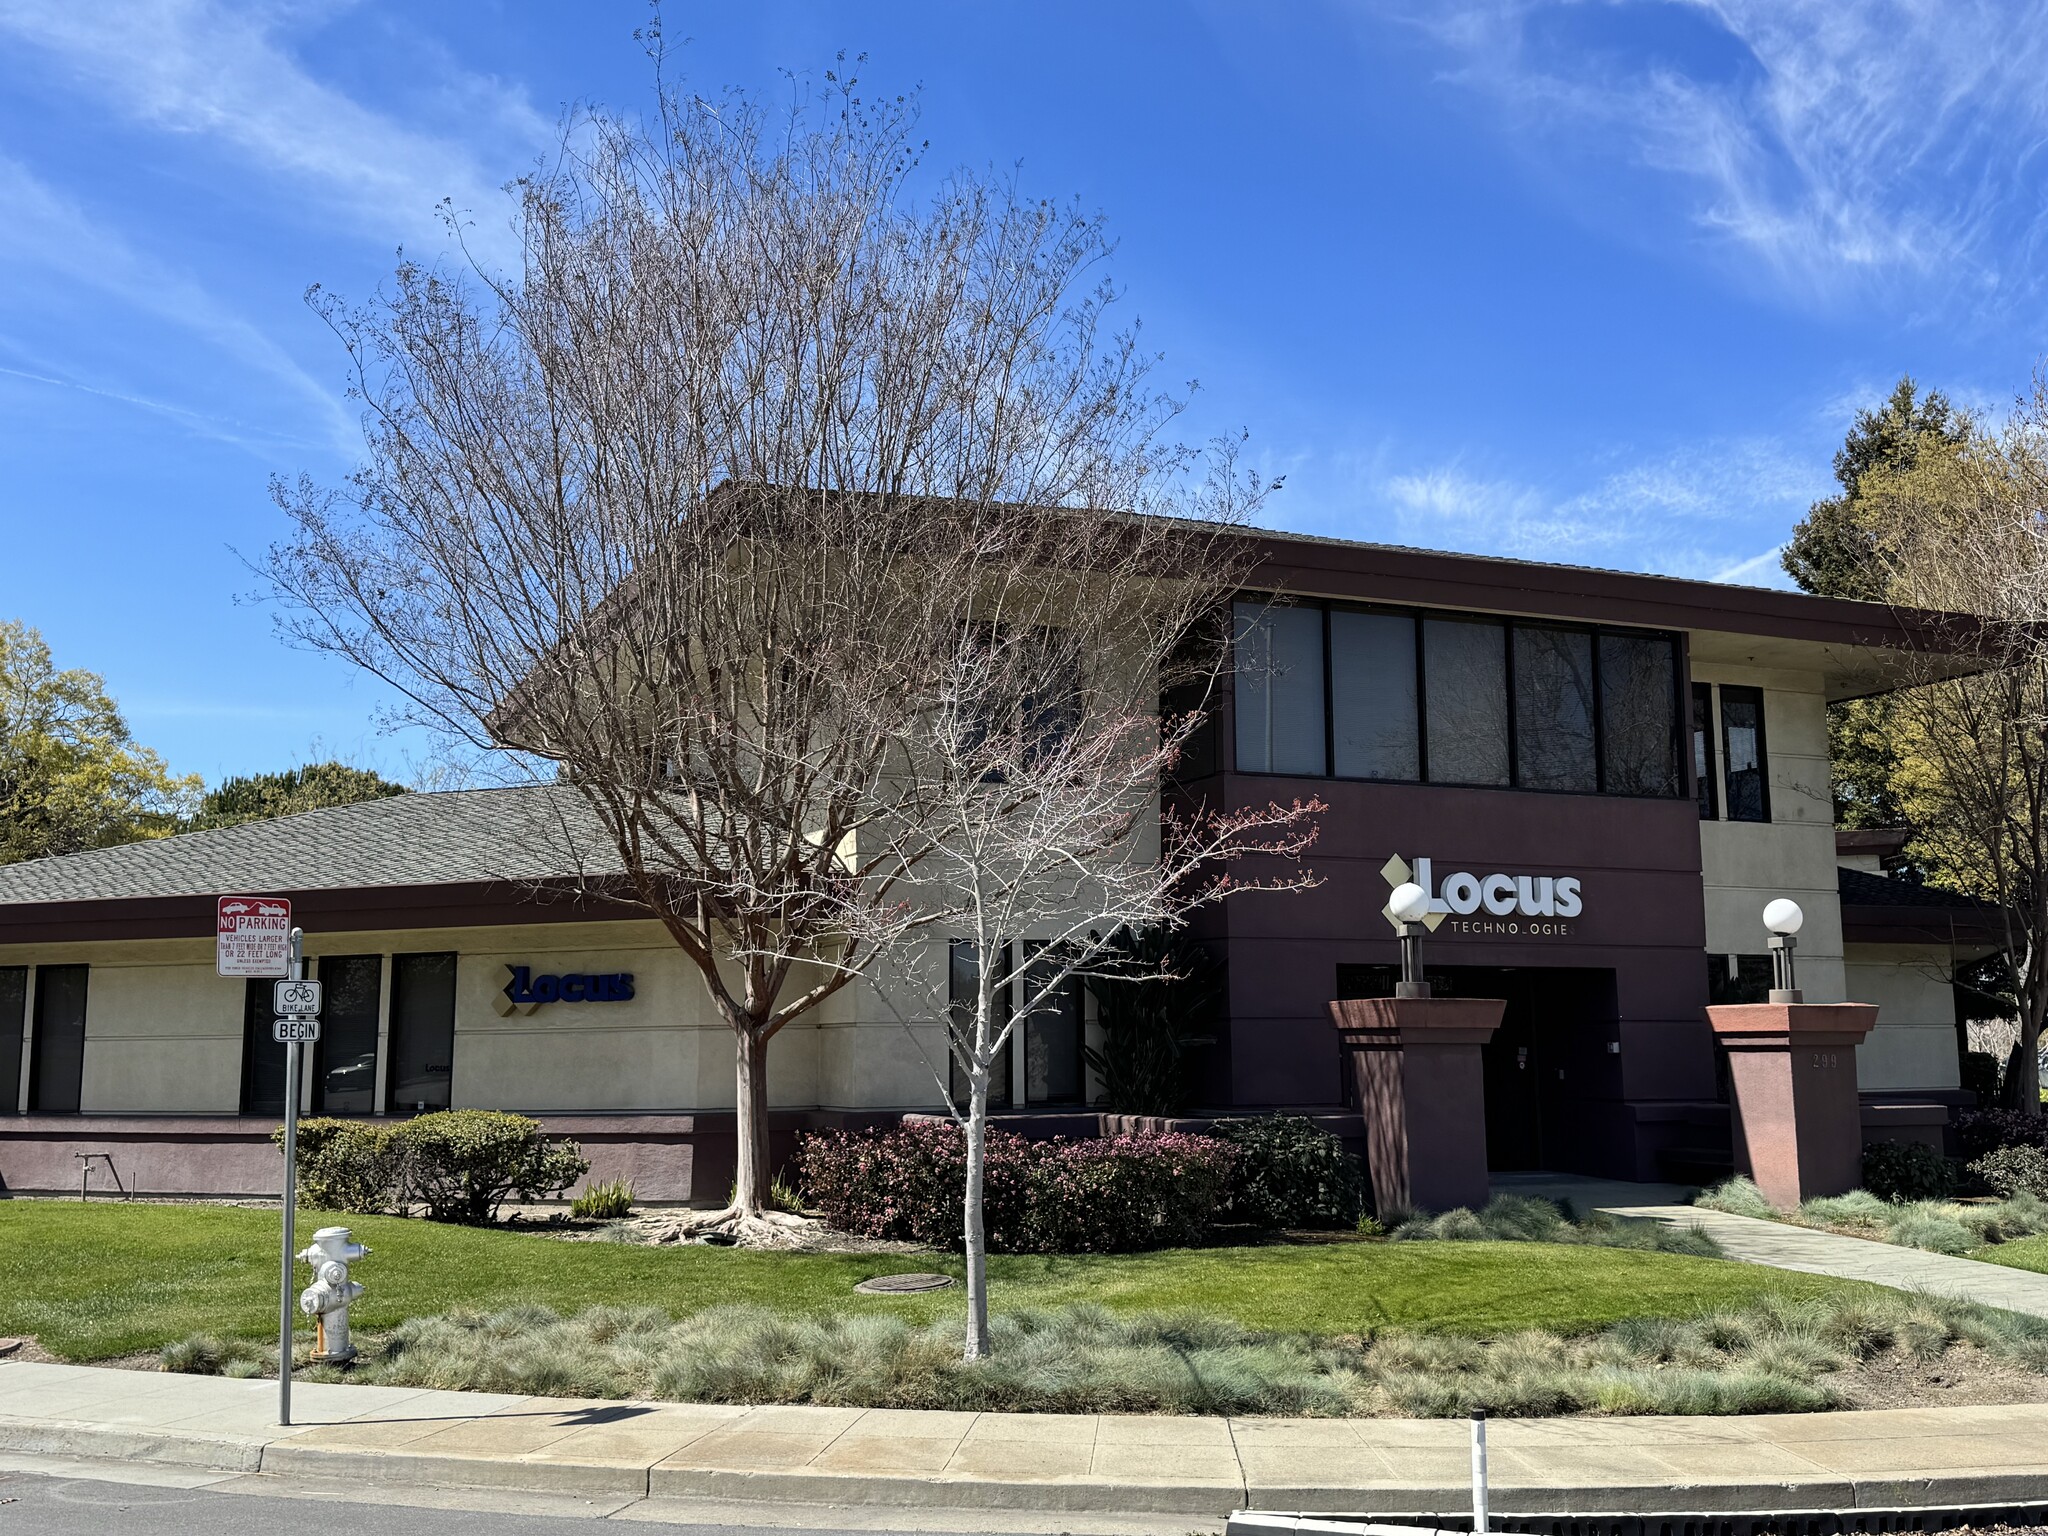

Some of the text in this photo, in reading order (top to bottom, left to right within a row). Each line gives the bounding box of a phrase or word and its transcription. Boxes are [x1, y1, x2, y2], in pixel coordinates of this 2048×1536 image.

[220, 916, 286, 930] NO PARKING
[226, 934, 283, 943] VEHICLES LARGER
[225, 950, 234, 958] OR
[237, 950, 245, 958] 22
[282, 1004, 315, 1012] BIKE LANE
[280, 1023, 315, 1038] BEGIN
[1813, 1054, 1837, 1068] 299
